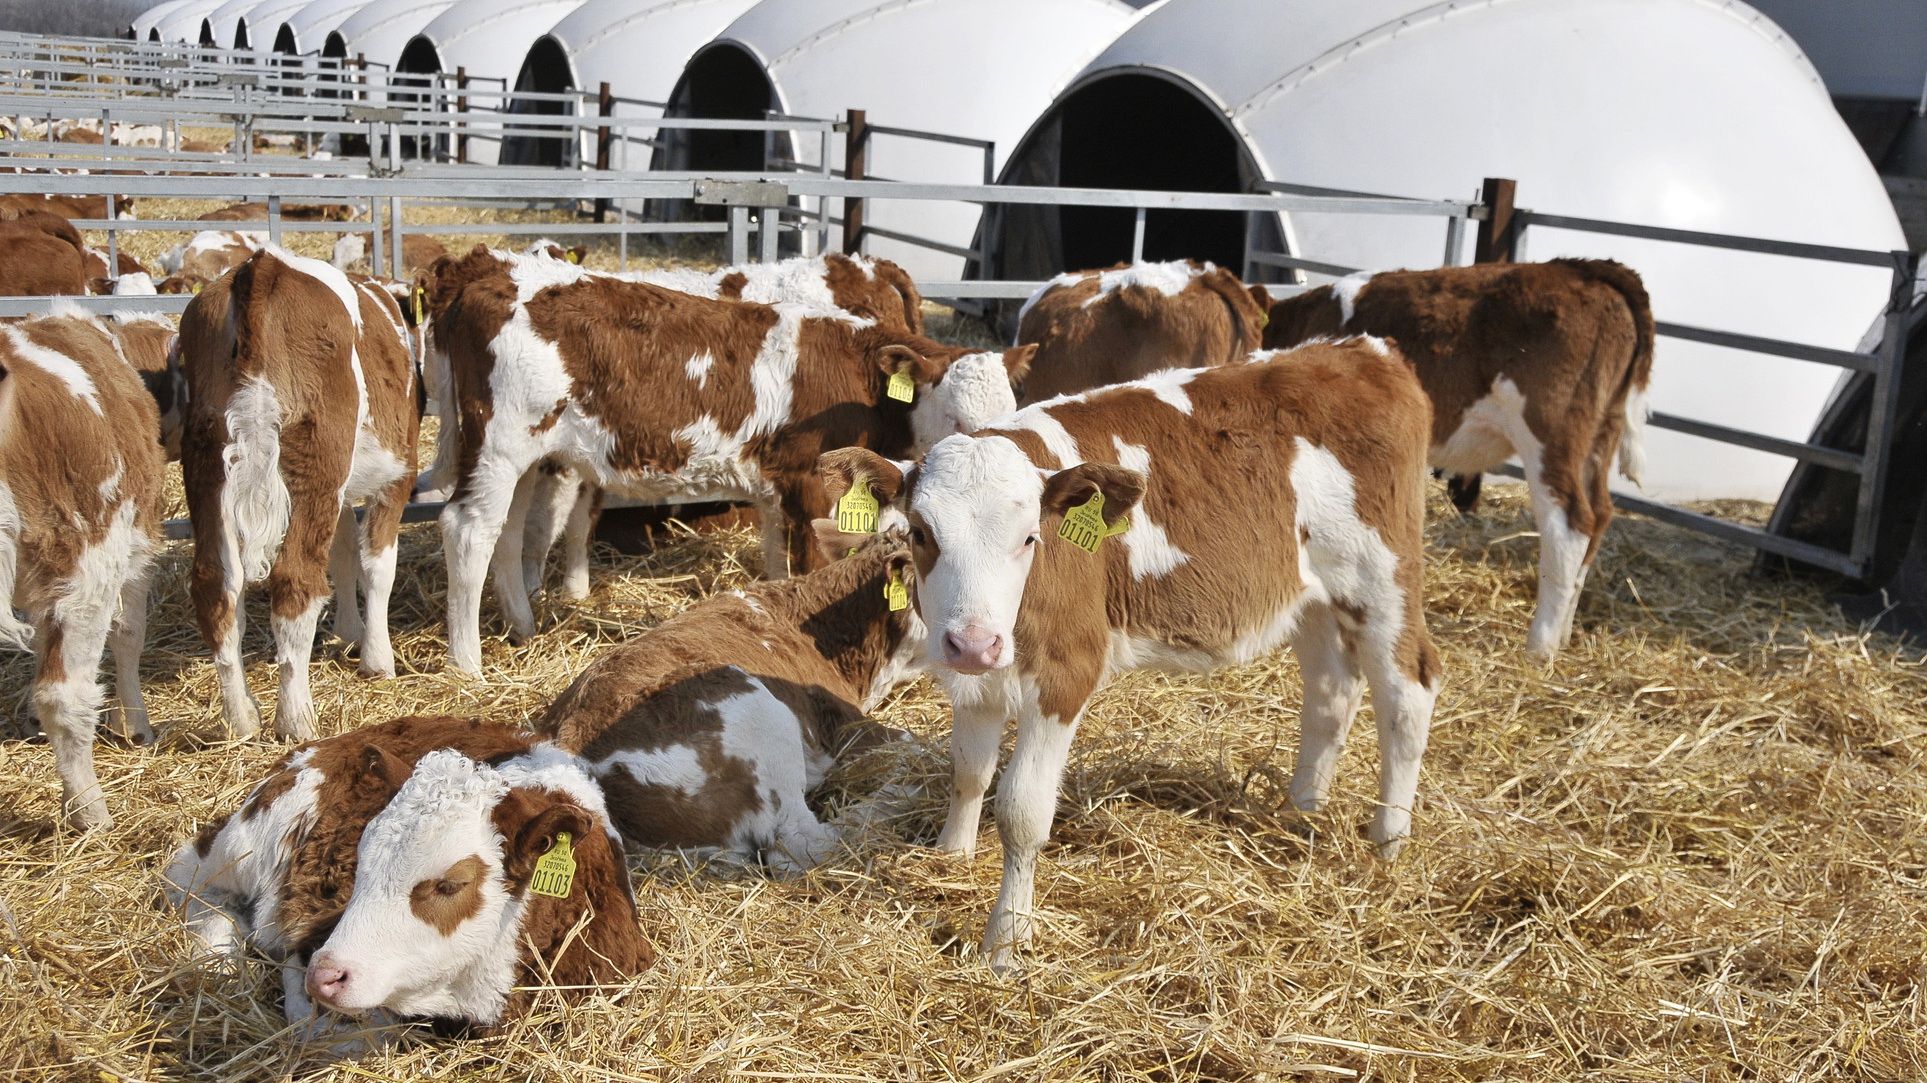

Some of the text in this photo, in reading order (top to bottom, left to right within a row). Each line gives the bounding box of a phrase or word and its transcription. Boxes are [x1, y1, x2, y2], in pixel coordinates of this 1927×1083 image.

[840, 510, 877, 533] 01101
[1072, 512, 1100, 532] 32070546
[1059, 518, 1099, 553] 01101
[543, 860, 569, 872] 32070546
[532, 869, 571, 896] 01103
